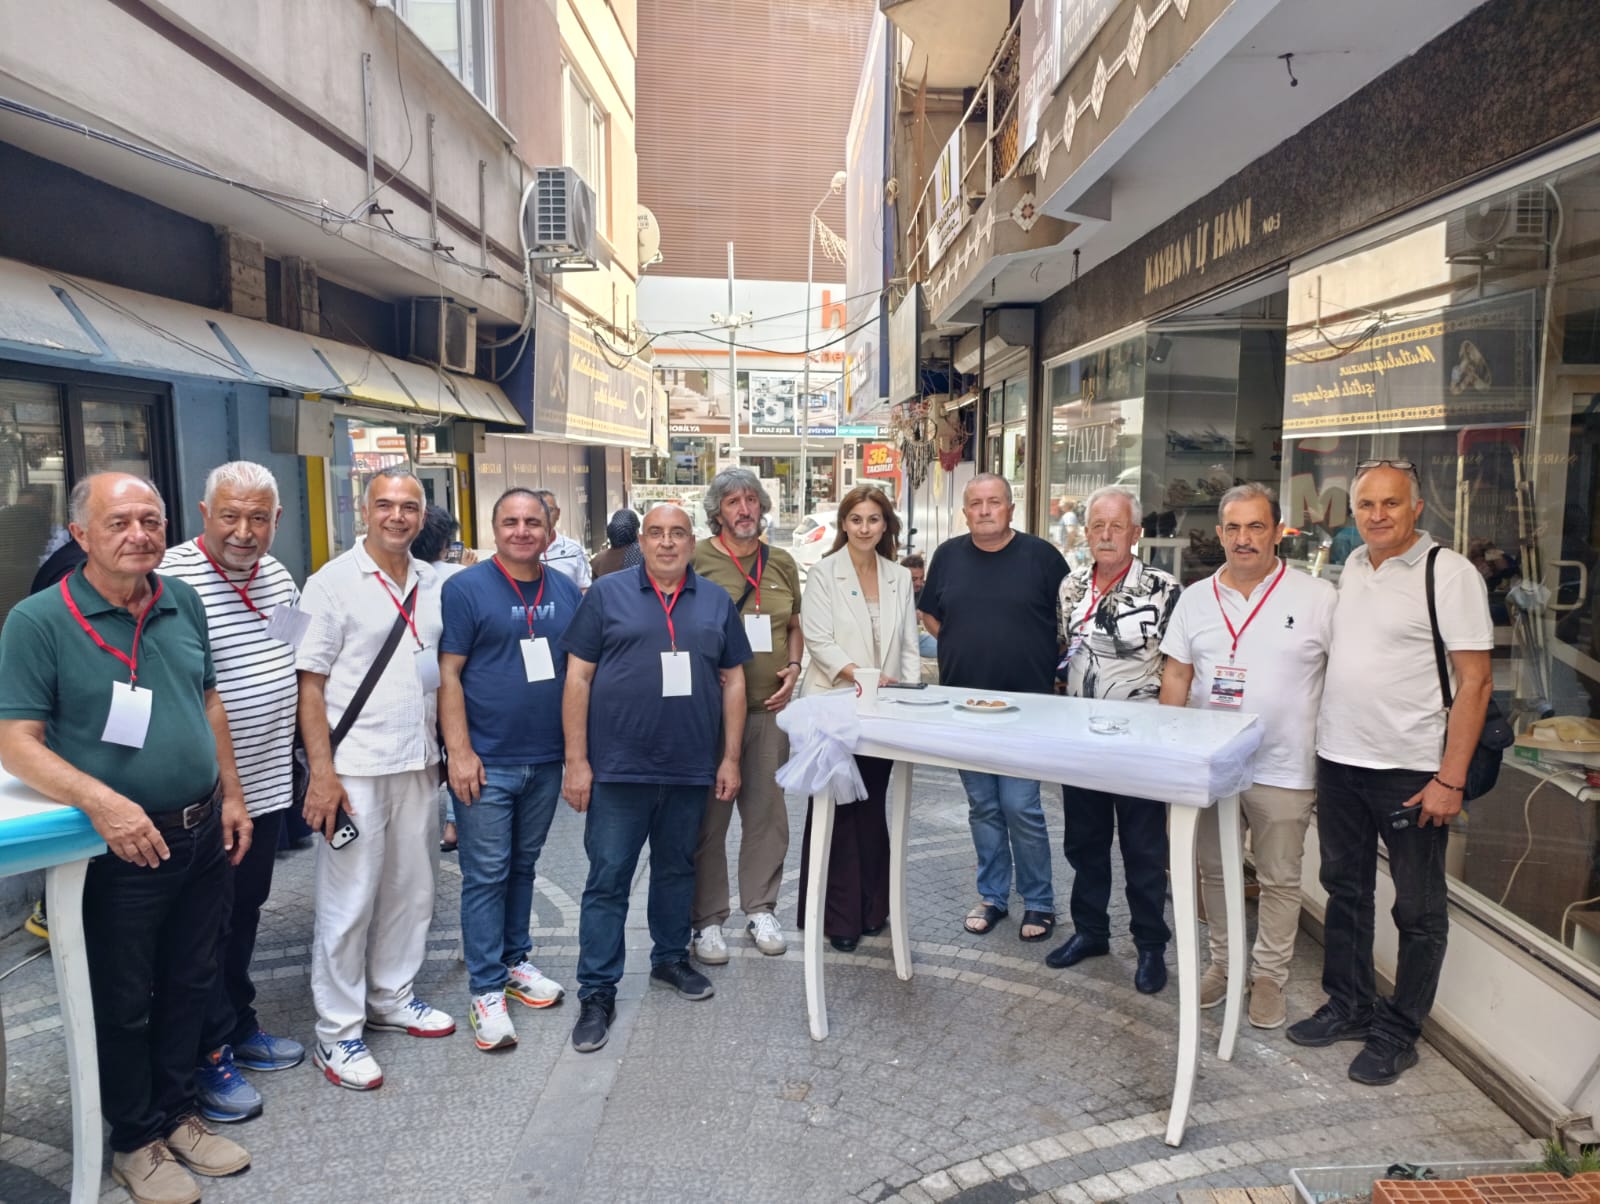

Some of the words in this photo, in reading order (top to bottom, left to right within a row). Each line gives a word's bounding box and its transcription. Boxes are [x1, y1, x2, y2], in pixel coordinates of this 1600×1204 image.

[1144, 231, 1192, 295] KAYHAN
[868, 447, 888, 465] 36
[1067, 425, 1108, 464] HAYAL
